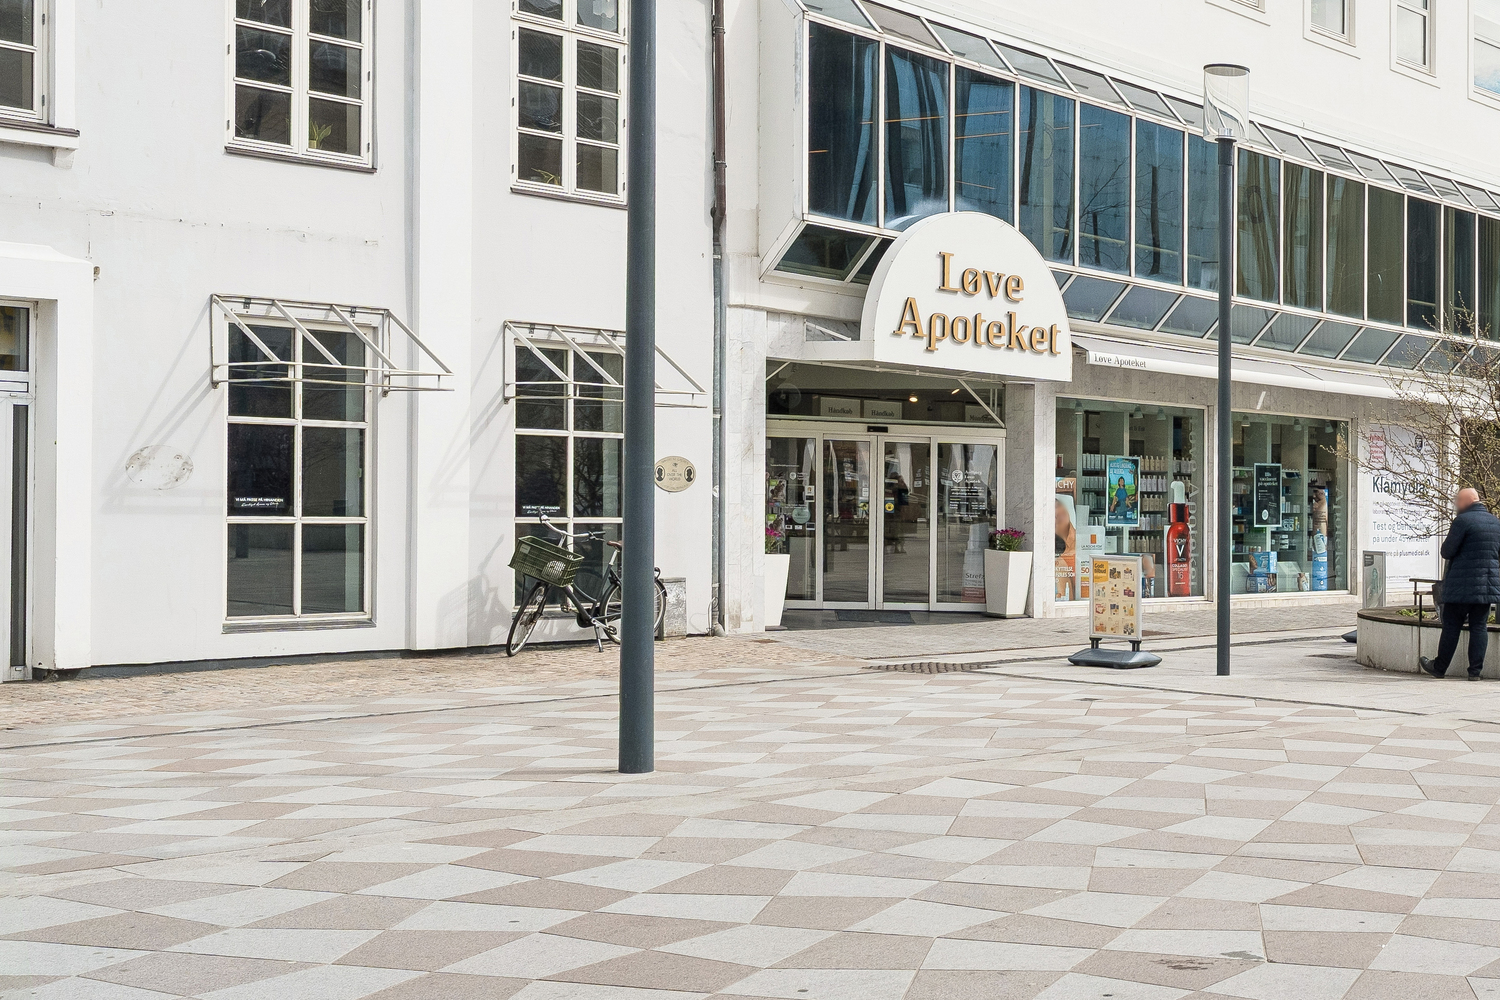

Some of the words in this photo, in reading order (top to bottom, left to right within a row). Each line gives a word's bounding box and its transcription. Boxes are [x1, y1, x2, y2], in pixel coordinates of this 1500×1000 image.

[938, 251, 1024, 302] Løve
[892, 296, 1062, 355] Apoteket
[1094, 354, 1112, 364] Løve
[1114, 356, 1147, 368] Apoteket
[1055, 480, 1074, 489] ICHY
[1372, 521, 1387, 531] Test
[1388, 523, 1395, 533] og
[1372, 534, 1380, 545] på
[1381, 535, 1398, 543] under
[1176, 544, 1184, 557] V
[1399, 549, 1430, 558] plusmedical.dk
